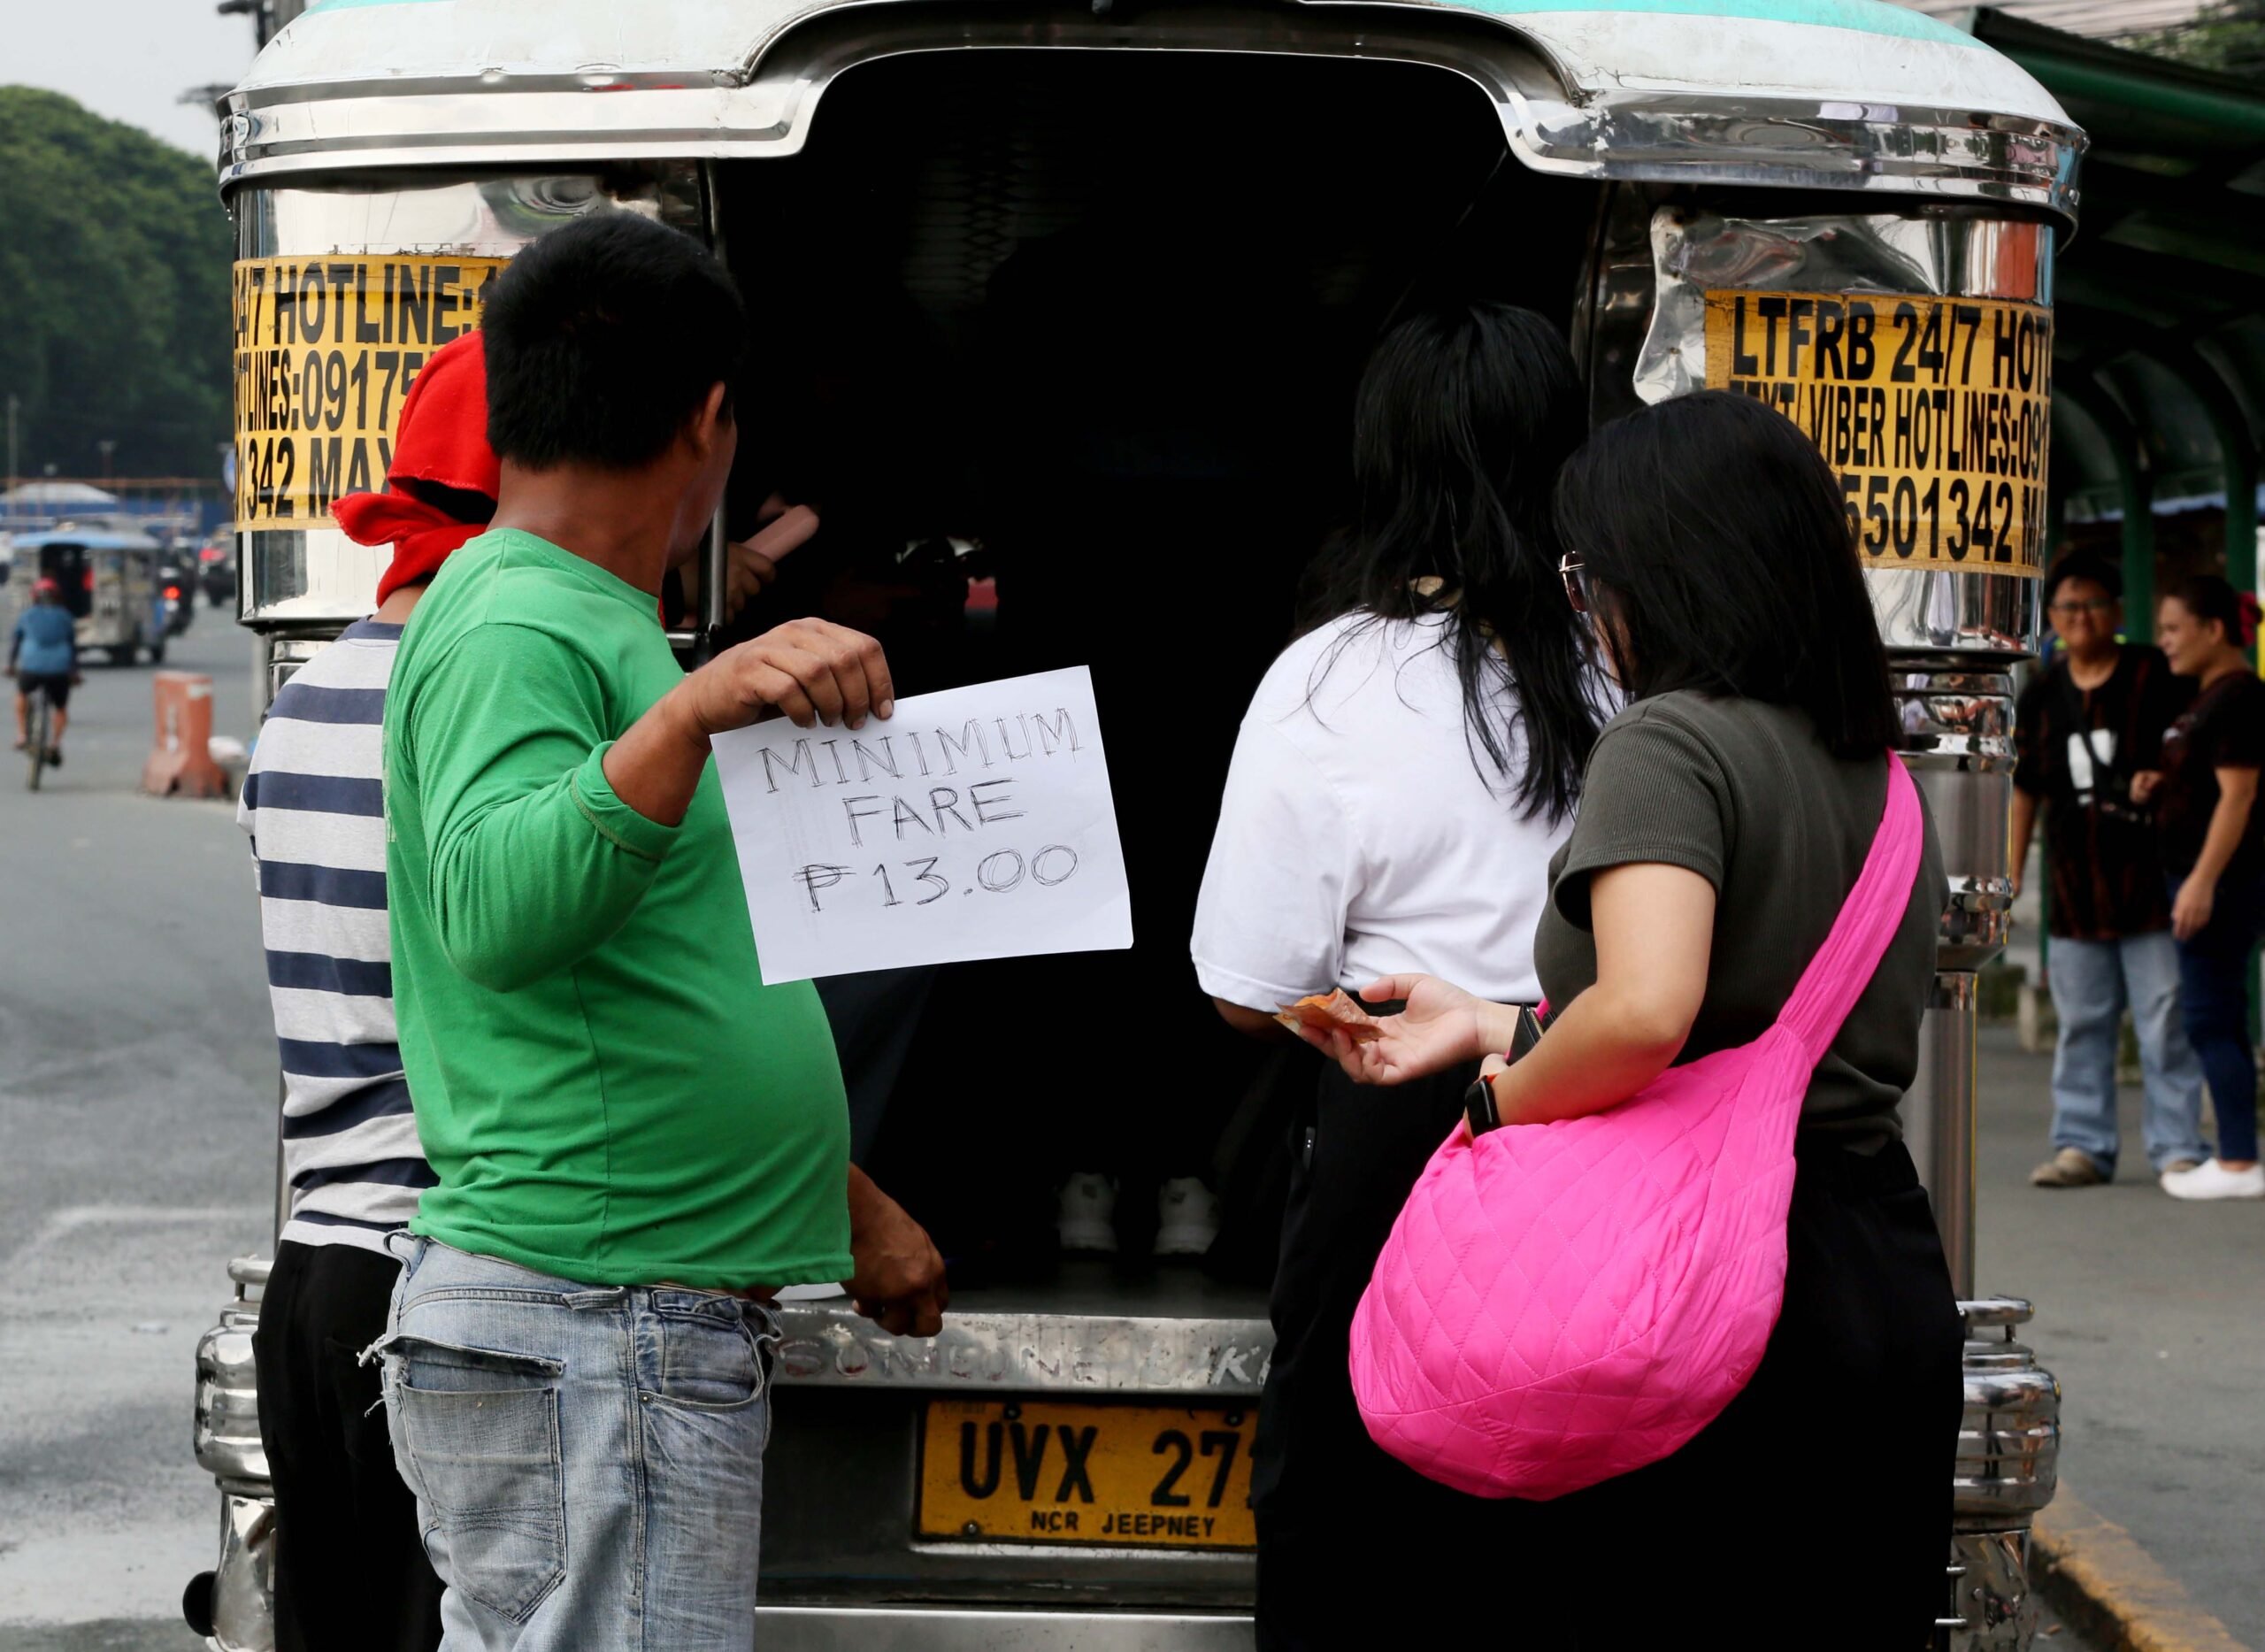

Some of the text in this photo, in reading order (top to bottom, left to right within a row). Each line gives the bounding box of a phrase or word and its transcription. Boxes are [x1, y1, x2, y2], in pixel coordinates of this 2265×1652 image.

[1732, 296, 1877, 381] LTFRB
[1891, 302, 1982, 386] 24/7
[1809, 382, 1886, 468] VIBER
[756, 708, 1085, 794] MINIMUM
[841, 778, 1028, 848] FARE
[960, 1421, 1254, 1509] UVX 27
[1031, 1510, 1217, 1537] NCR JEEPNEY
